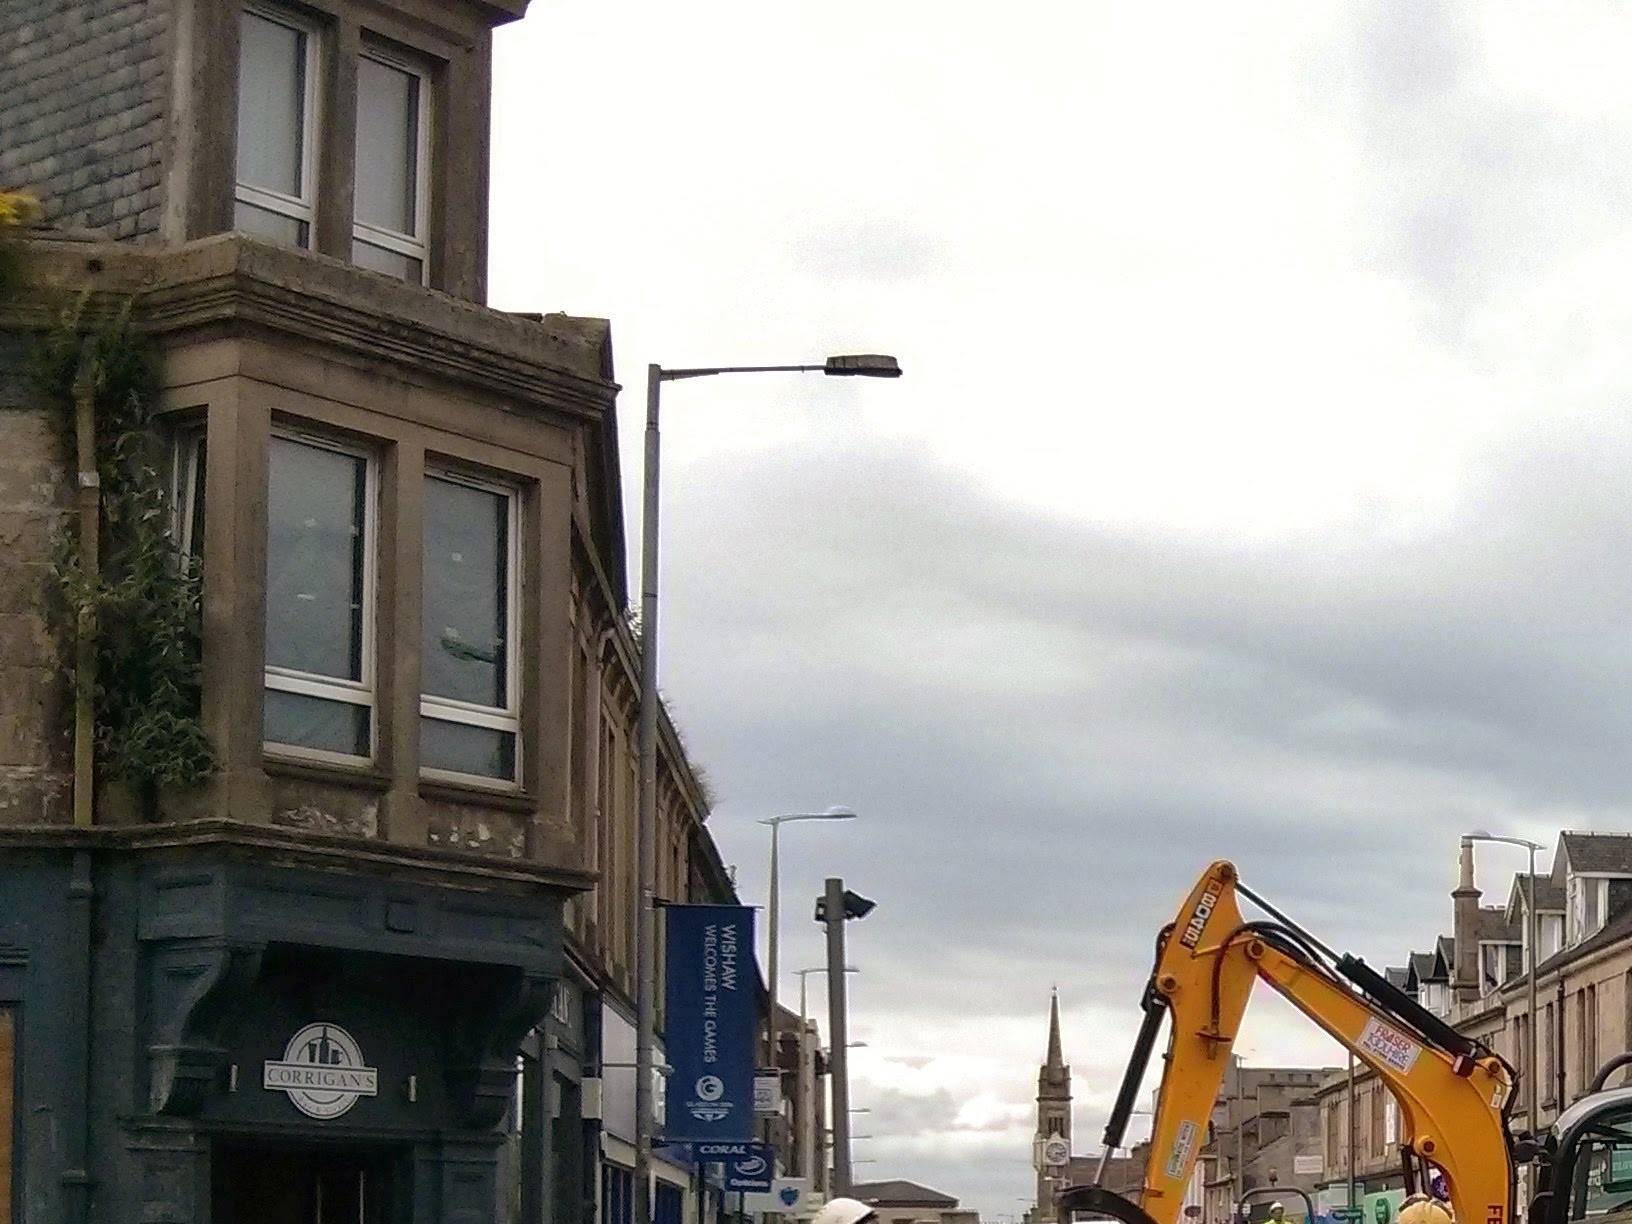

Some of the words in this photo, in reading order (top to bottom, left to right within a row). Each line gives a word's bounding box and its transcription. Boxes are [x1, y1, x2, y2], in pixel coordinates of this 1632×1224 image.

[704, 924, 717, 992] WELCOMES
[721, 924, 737, 991] WISHAW
[704, 994, 717, 1018] THE
[704, 1021, 718, 1063] GAMES
[1375, 1026, 1411, 1054] FRASER
[699, 1144, 747, 1155] CORAL
